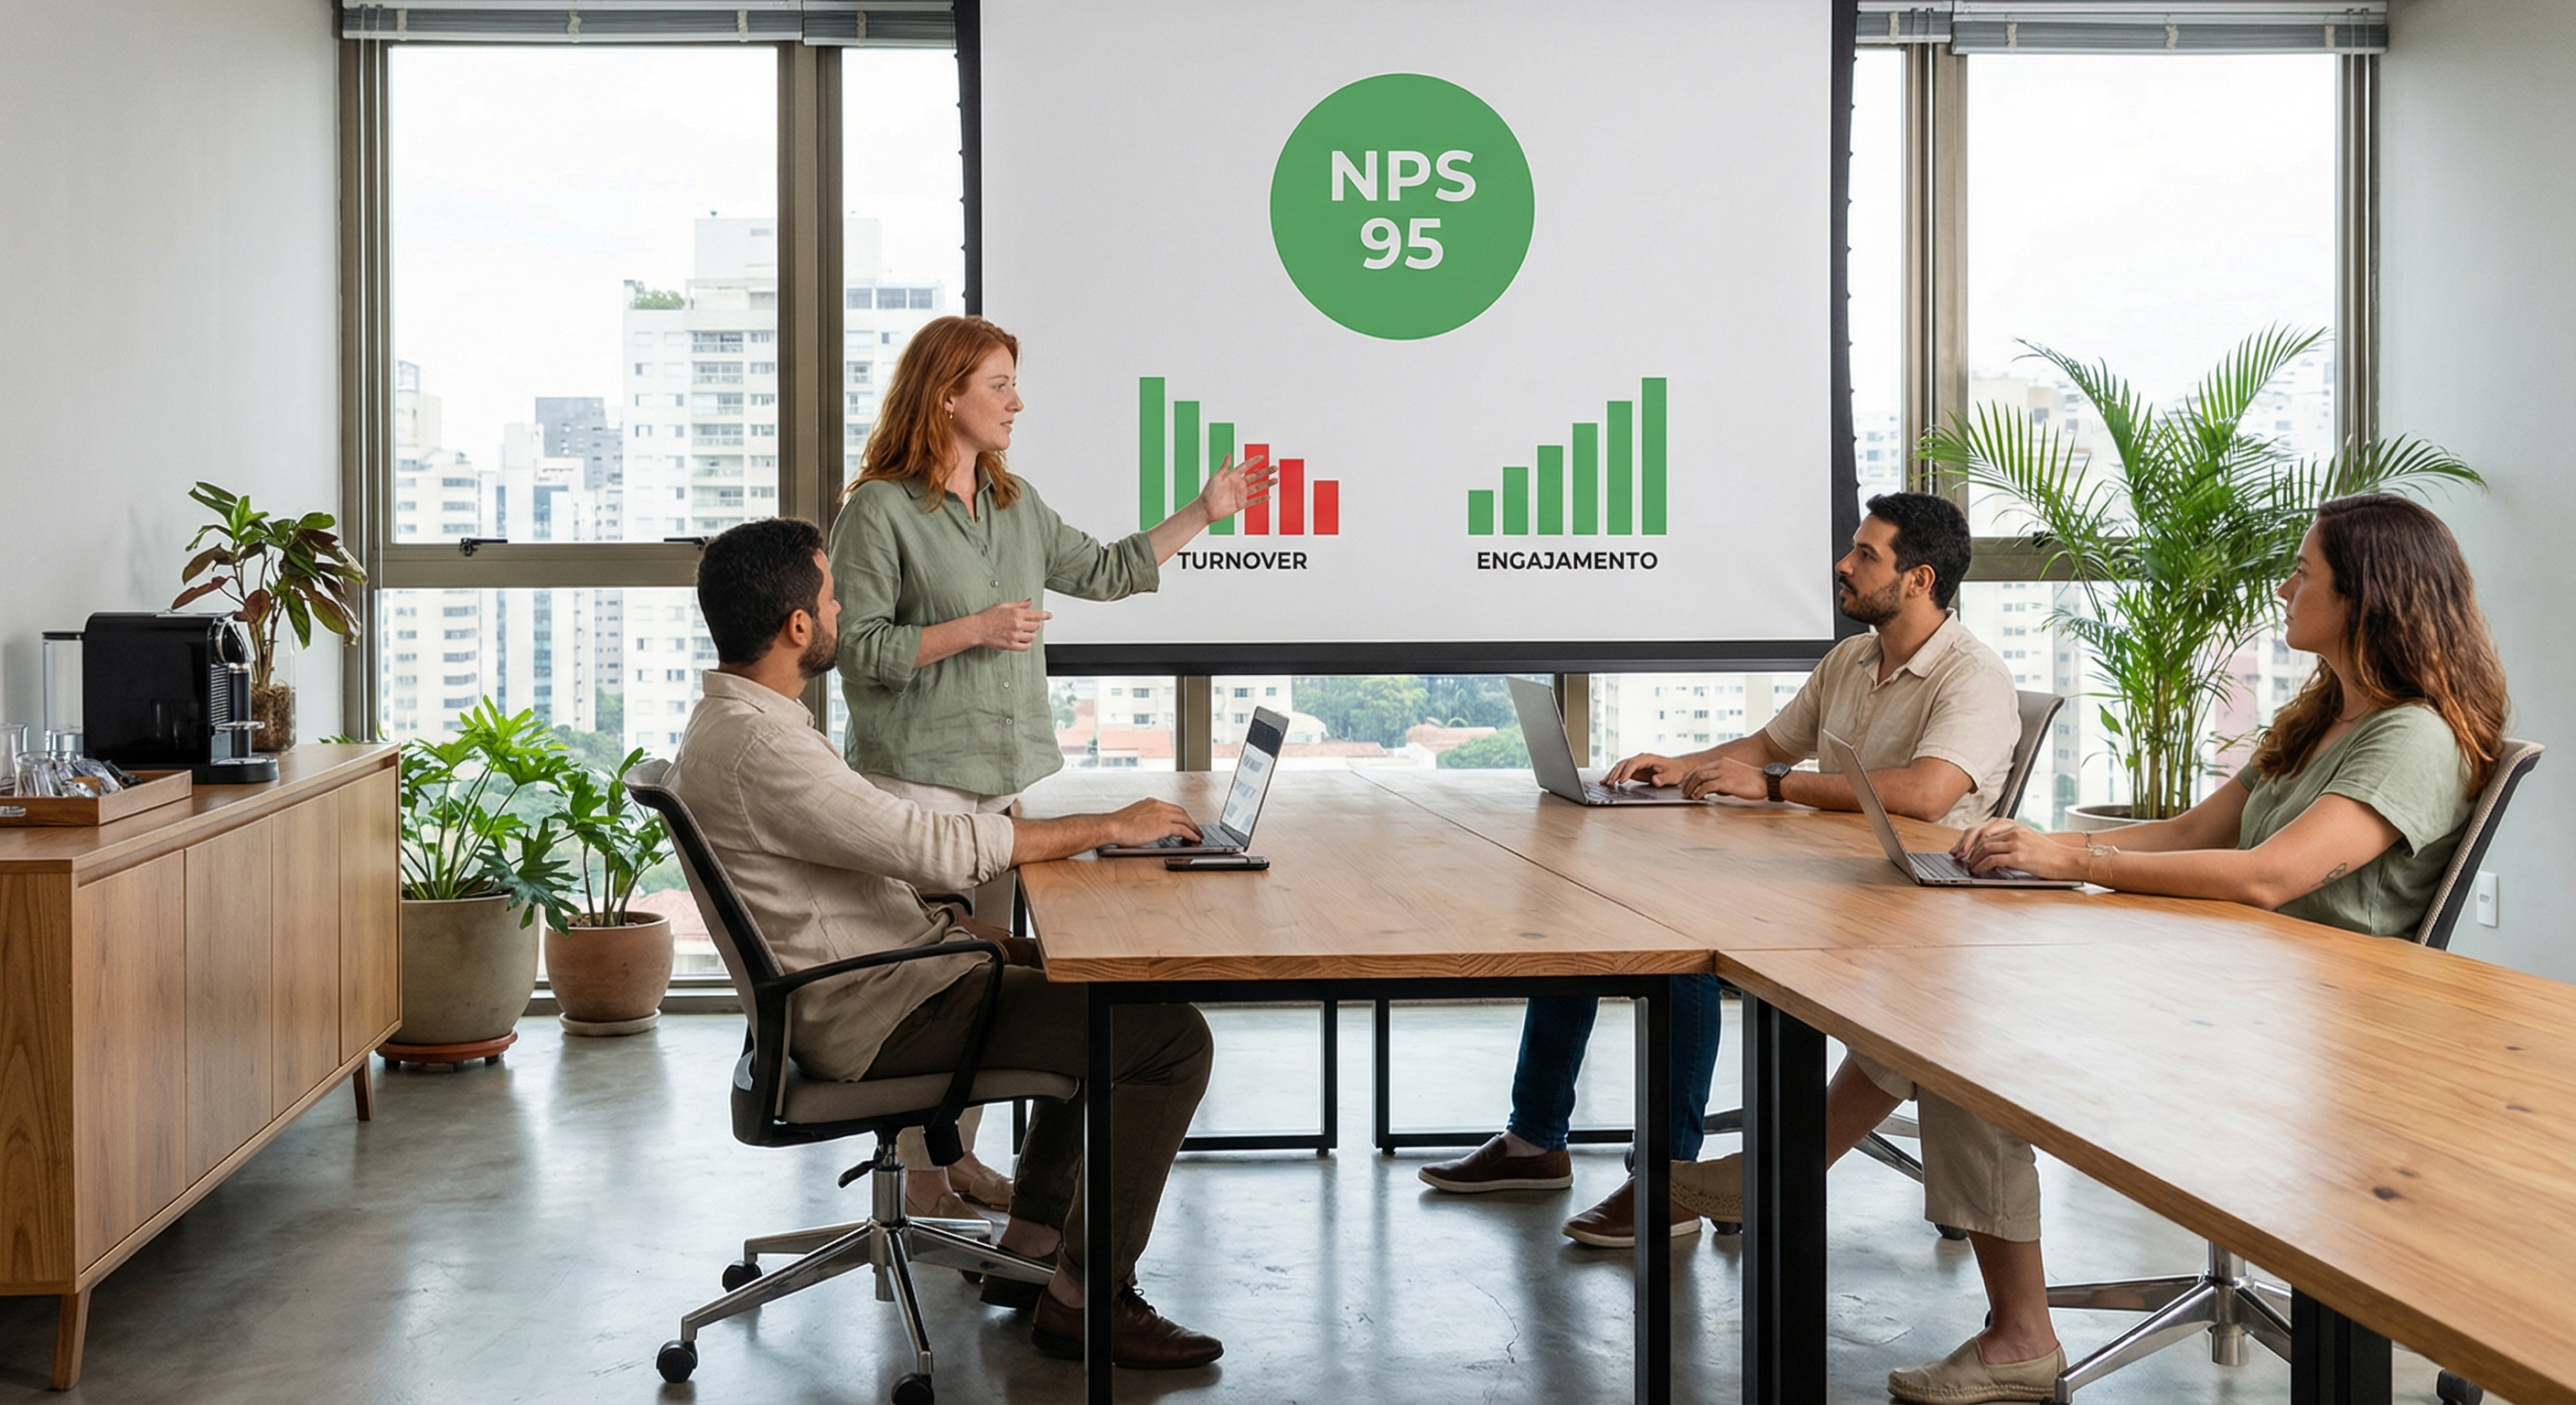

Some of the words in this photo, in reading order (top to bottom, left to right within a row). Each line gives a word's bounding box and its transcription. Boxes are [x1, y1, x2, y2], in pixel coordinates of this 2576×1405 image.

[1331, 150, 1476, 202] NPS
[1360, 218, 1444, 270] 95
[1176, 552, 1307, 570] TURNOVER
[1477, 552, 1658, 570] ENGAJAMENTO
